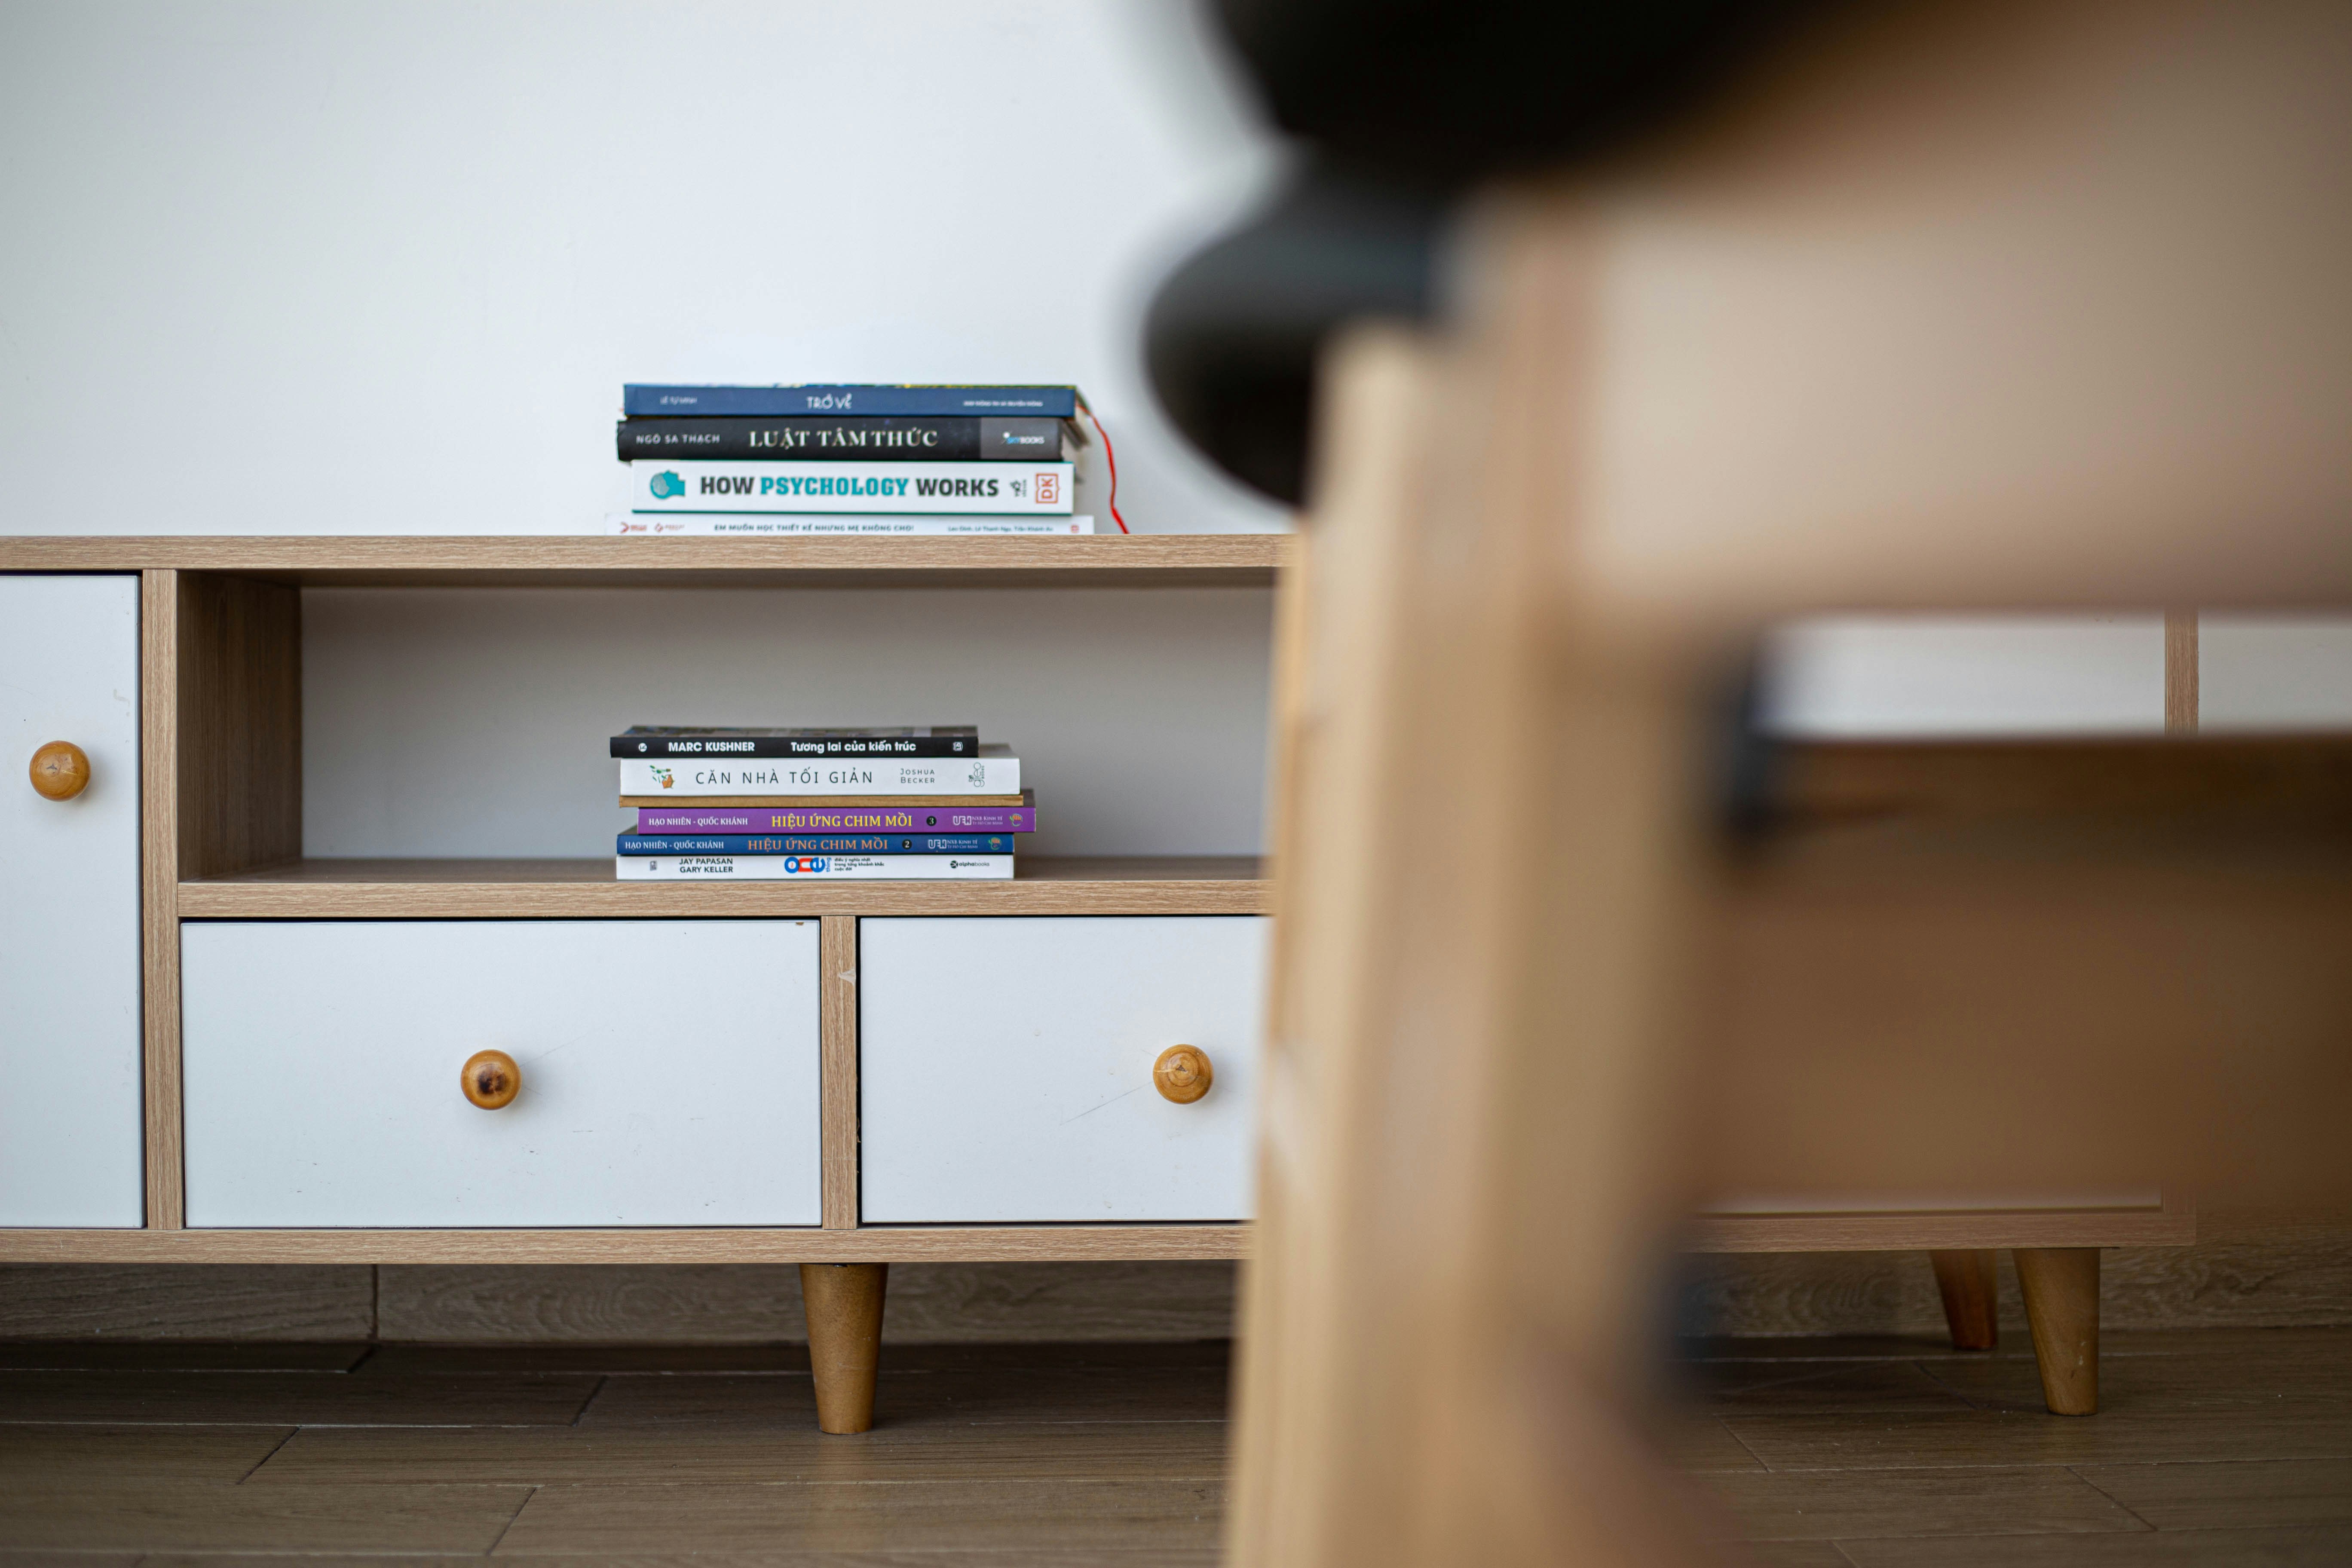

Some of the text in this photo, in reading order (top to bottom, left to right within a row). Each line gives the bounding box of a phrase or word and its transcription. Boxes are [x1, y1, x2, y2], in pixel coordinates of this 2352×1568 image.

[807, 393, 852, 409] TRỞ VỀ
[636, 433, 720, 445] NGÔ SA THẠCH
[750, 427, 937, 450] LUẬT TÂM THỨC
[701, 477, 998, 496] HOW PSYCHOLOGY WORKS
[1041, 478, 1053, 499] DK
[668, 742, 755, 751] MARC KUSHNER
[791, 740, 916, 753] Tương lai của kiến trúc
[696, 767, 871, 784] CĂN NHÀ TỐI GIẢN
[698, 817, 719, 826] QUỐC
[721, 817, 747, 825] KHÁNH
[772, 812, 911, 829] HIỆU ỨNG CHIM MỒI
[625, 842, 641, 850] HẠO
[643, 840, 667, 848] NHIÊN
[674, 840, 695, 850] QUỐC
[697, 840, 723, 848] KHÁNH
[748, 837, 887, 851] HIỆU ỨNG CHIM MỒI
